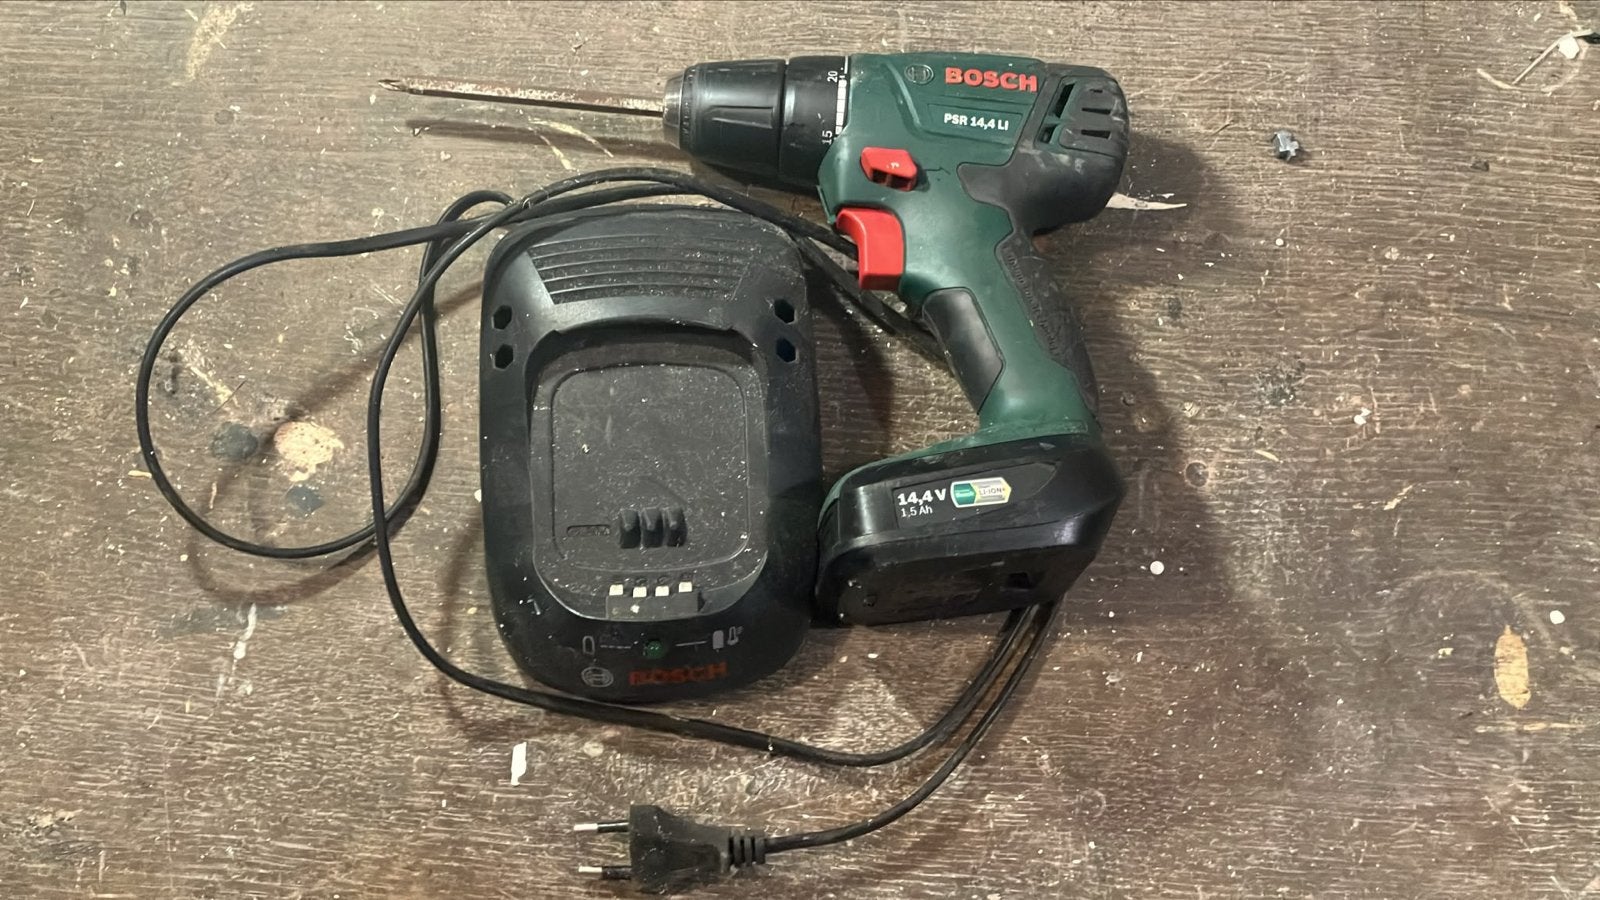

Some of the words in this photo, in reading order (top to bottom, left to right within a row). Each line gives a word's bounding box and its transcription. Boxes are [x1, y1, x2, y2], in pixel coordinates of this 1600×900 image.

[826, 70, 838, 83] 20
[945, 66, 1038, 93] BOSCH
[944, 113, 967, 126] PSR
[970, 116, 996, 129] 14,4
[997, 118, 1009, 131] LI
[821, 130, 833, 145] 15
[897, 490, 933, 507] 14,4
[935, 488, 947, 502] V
[900, 507, 918, 518] 1,5
[918, 505, 933, 516] Ah
